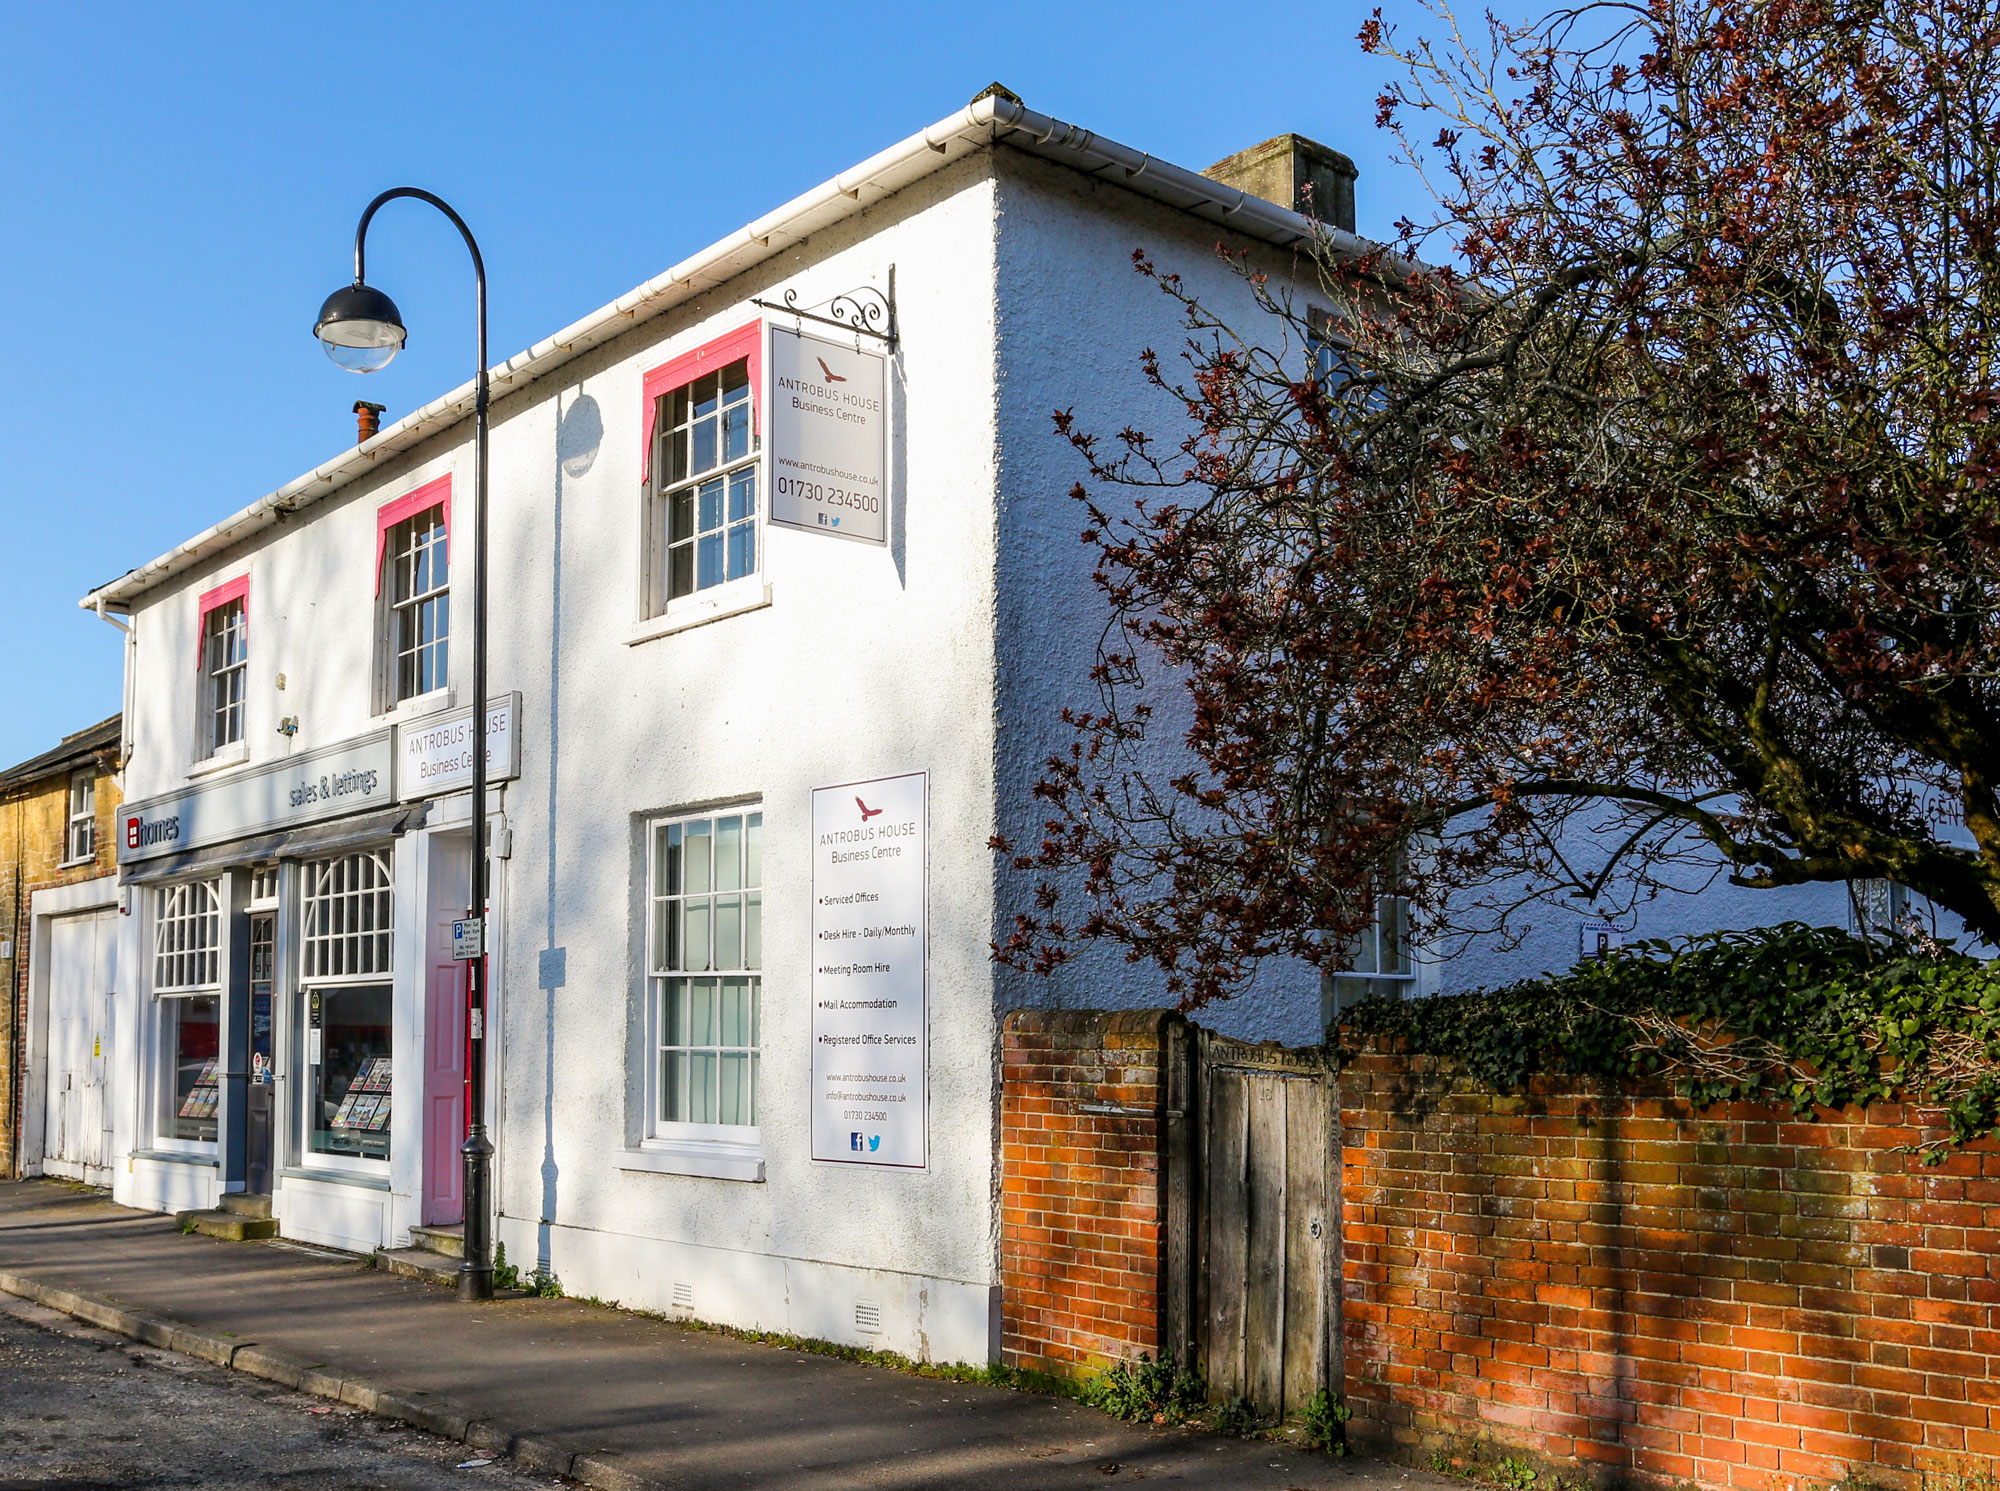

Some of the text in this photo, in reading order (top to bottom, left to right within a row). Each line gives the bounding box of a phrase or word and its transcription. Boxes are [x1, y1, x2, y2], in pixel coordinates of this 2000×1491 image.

[778, 376, 879, 412] ANTROBUS HOUSE
[792, 397, 866, 425] Business Centre
[778, 456, 879, 486] www.antrobushouse.co.uk
[778, 477, 879, 513] 01730 234500
[408, 713, 506, 756] ANTROBUS HUSE
[420, 749, 491, 779] Business Cee
[289, 768, 377, 807] sales & lettings
[139, 816, 179, 847] homes
[820, 822, 916, 846] ANTROBUS HOUSE
[831, 845, 901, 864] Business Centre
[824, 892, 879, 906] Serviced Offices
[824, 929, 840, 941] Desk
[842, 928, 856, 939] Hire
[863, 924, 916, 940] Daily/Monthly
[824, 963, 890, 976] Meeting Room Hire
[824, 998, 897, 1010] Mail Accommodation
[823, 1034, 917, 1047] Registered Office Services
[1211, 1044, 1276, 1064] ANTROBUS
[826, 1073, 906, 1084] www.antrobushouse.co.uk
[826, 1090, 907, 1103] info@antrobushouse.co.uk
[843, 1110, 887, 1122] 01730 234500
